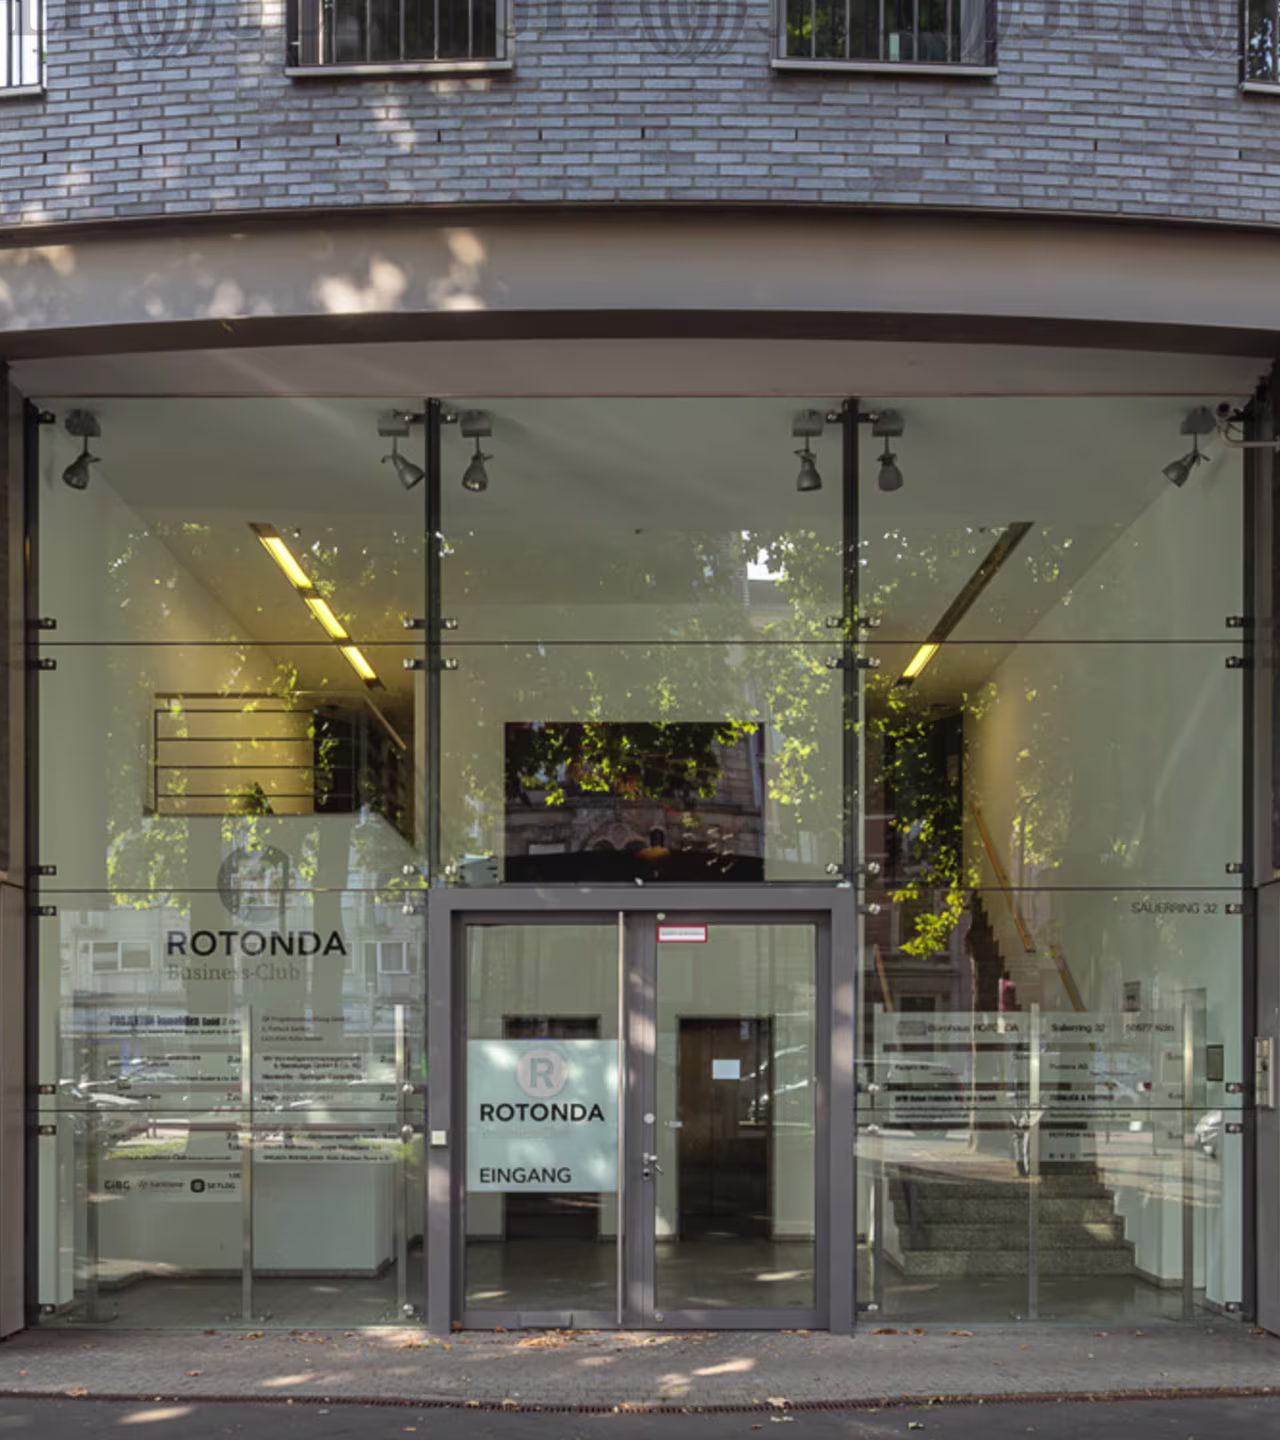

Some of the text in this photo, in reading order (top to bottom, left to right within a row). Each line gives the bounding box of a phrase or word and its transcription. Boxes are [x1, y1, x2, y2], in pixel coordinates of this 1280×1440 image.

[1203, 903, 1218, 914] 32
[167, 930, 347, 956] ROTONDA
[167, 962, 300, 981] Business-Club
[529, 1057, 554, 1089] R
[480, 1103, 605, 1122] ROTONDA
[480, 1167, 572, 1184] EINGANG
